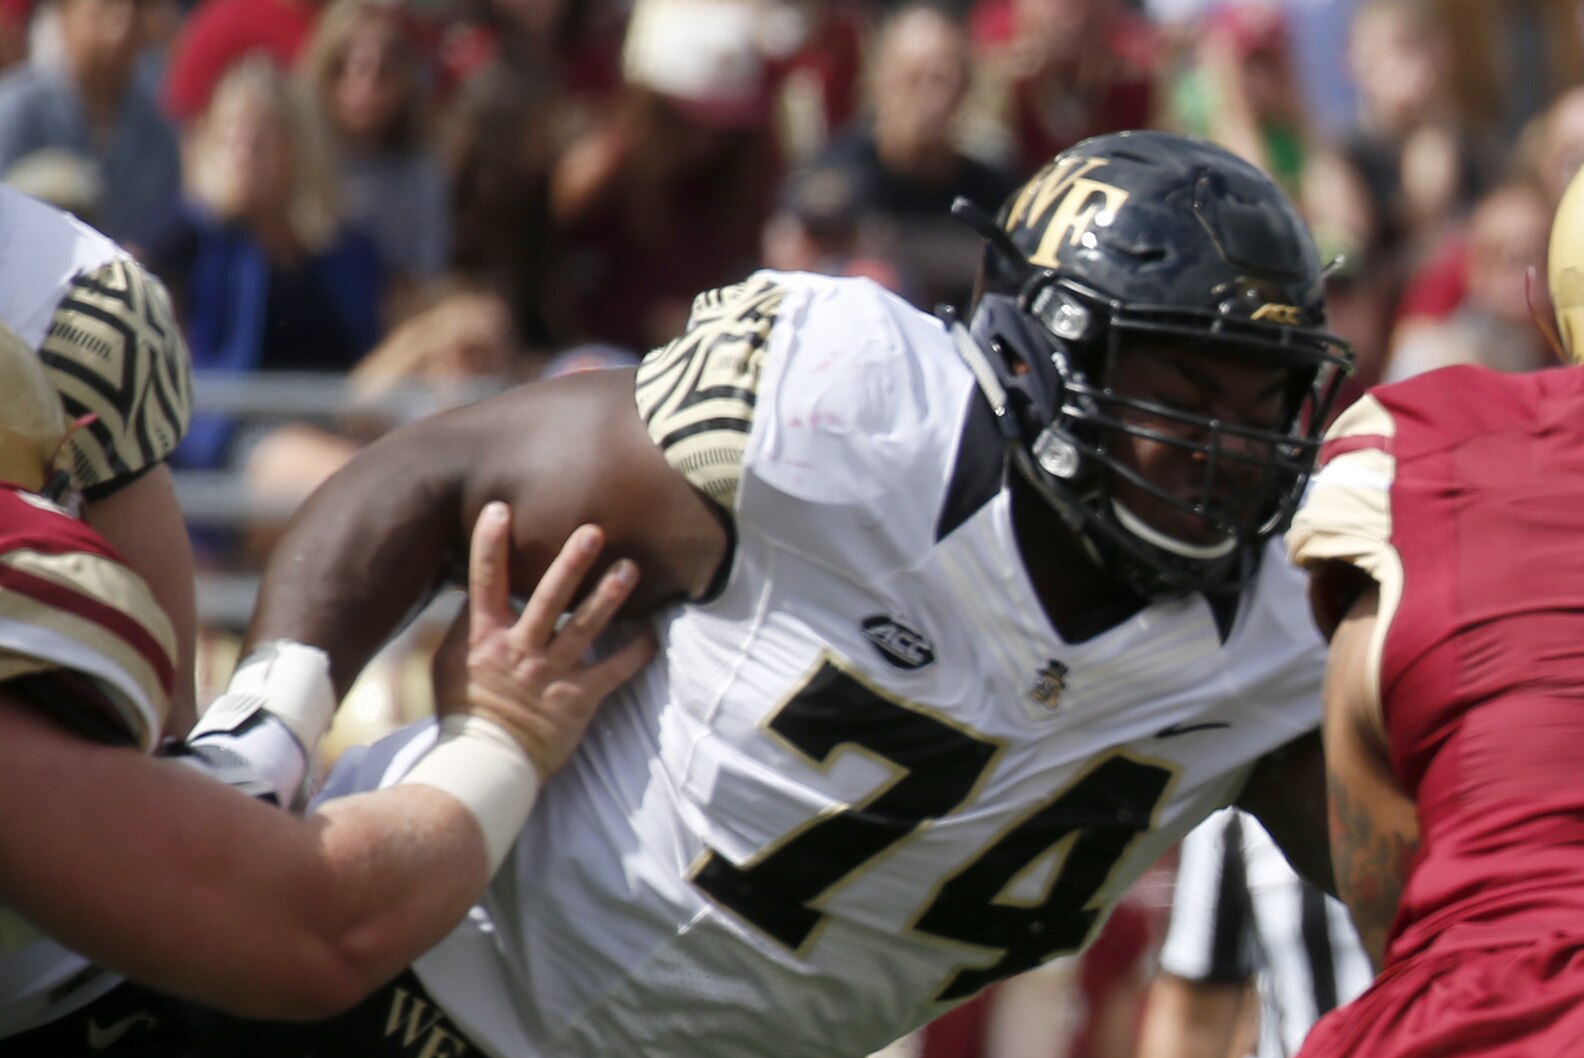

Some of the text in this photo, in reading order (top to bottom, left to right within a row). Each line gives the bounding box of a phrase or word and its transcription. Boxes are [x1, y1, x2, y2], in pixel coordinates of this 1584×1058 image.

[1005, 156, 1130, 269] WF
[864, 624, 930, 665] ACC
[683, 648, 1182, 1002] 74
